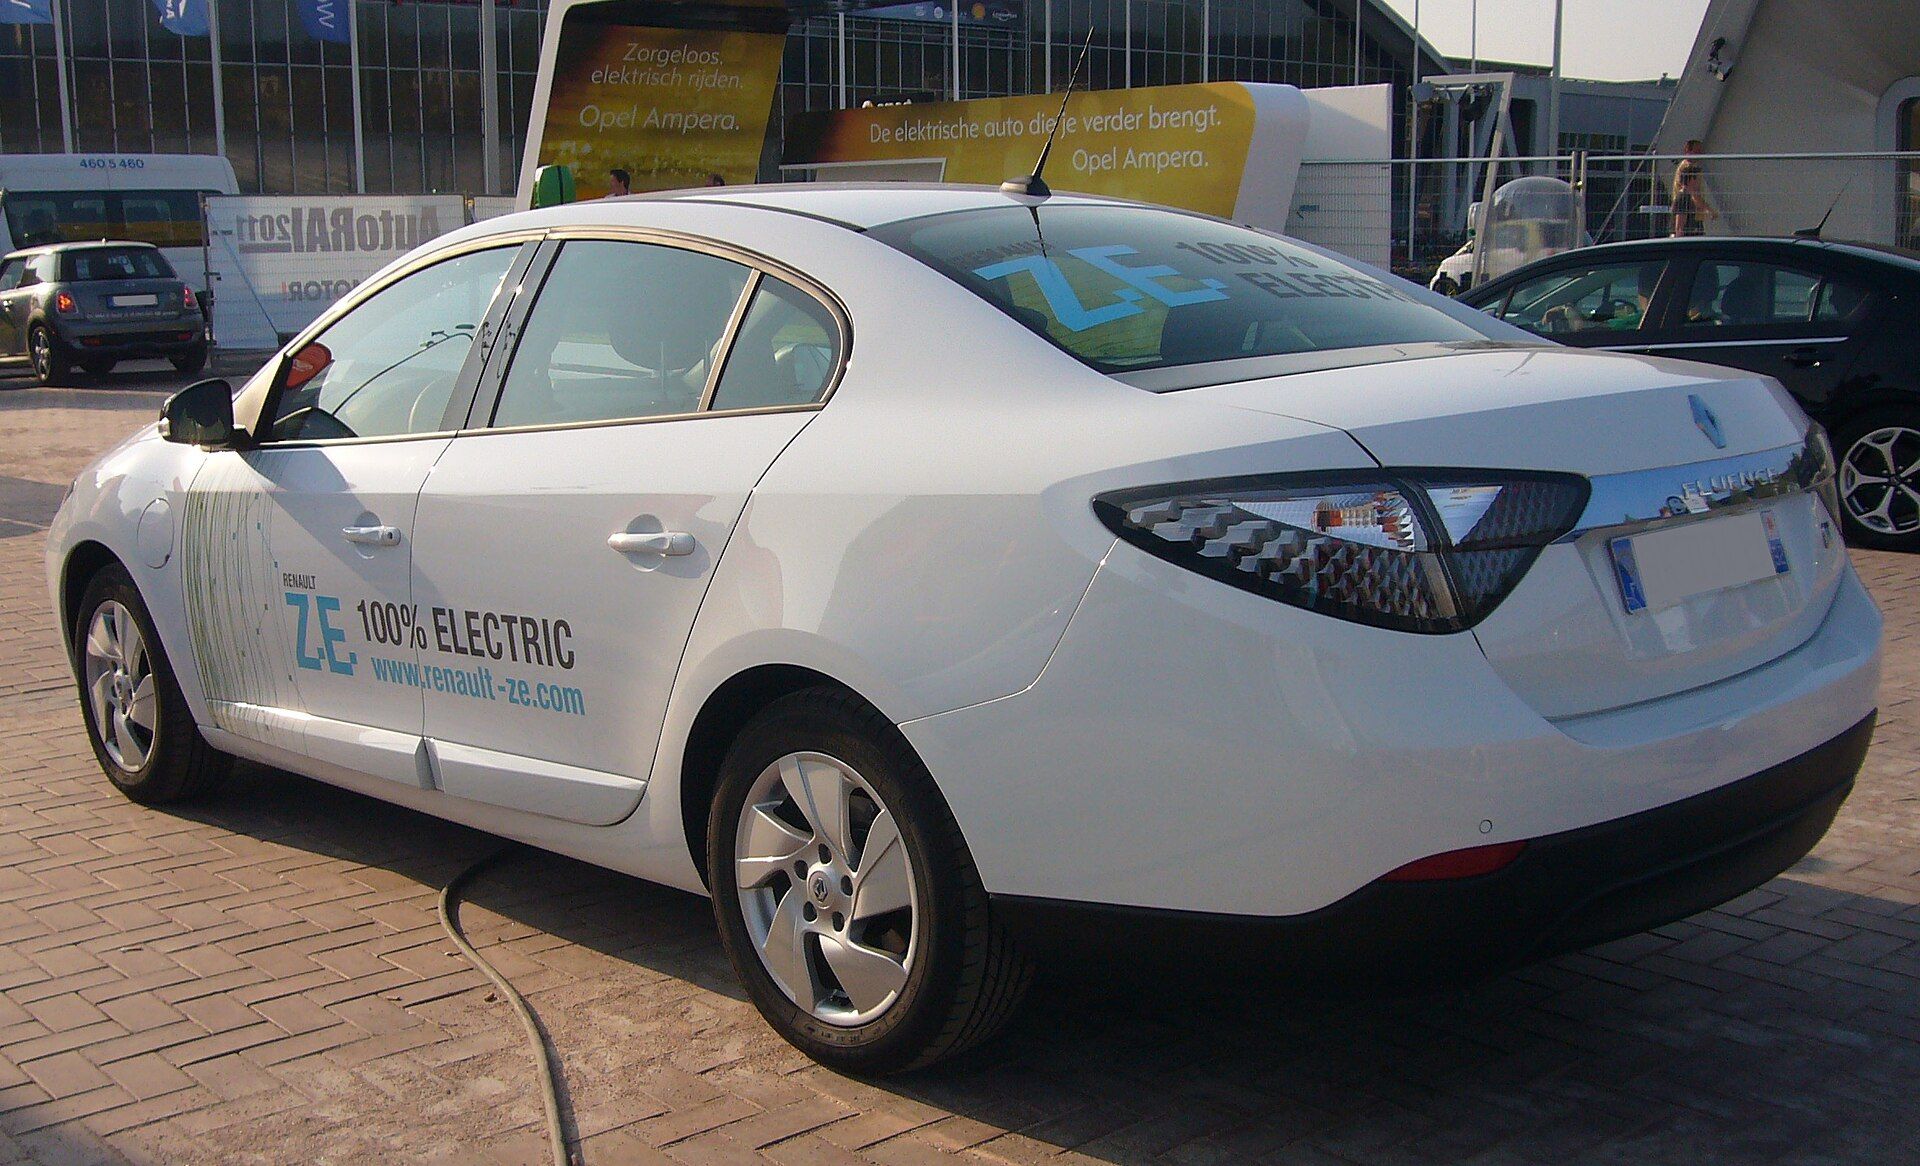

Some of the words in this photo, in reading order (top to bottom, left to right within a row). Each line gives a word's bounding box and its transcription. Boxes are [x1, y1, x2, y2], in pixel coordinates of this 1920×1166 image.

[591, 65, 682, 86] elektrisch
[689, 69, 744, 91] rijden.
[579, 104, 637, 132] Opel
[643, 107, 740, 135] Ampera.
[870, 123, 890, 143] De
[895, 117, 979, 142] elektrische
[984, 116, 1024, 138] auto
[1029, 112, 1056, 135] die
[1060, 110, 1077, 139] je
[1083, 107, 1143, 132] verder
[1149, 104, 1222, 133] brengt.
[1072, 147, 1117, 176] Opel
[1122, 148, 1209, 174] Ampera.
[1176, 241, 1318, 269] 100%
[283, 573, 316, 590] RENAULT
[357, 599, 428, 650] 100%
[431, 606, 575, 670] ELECTRIC
